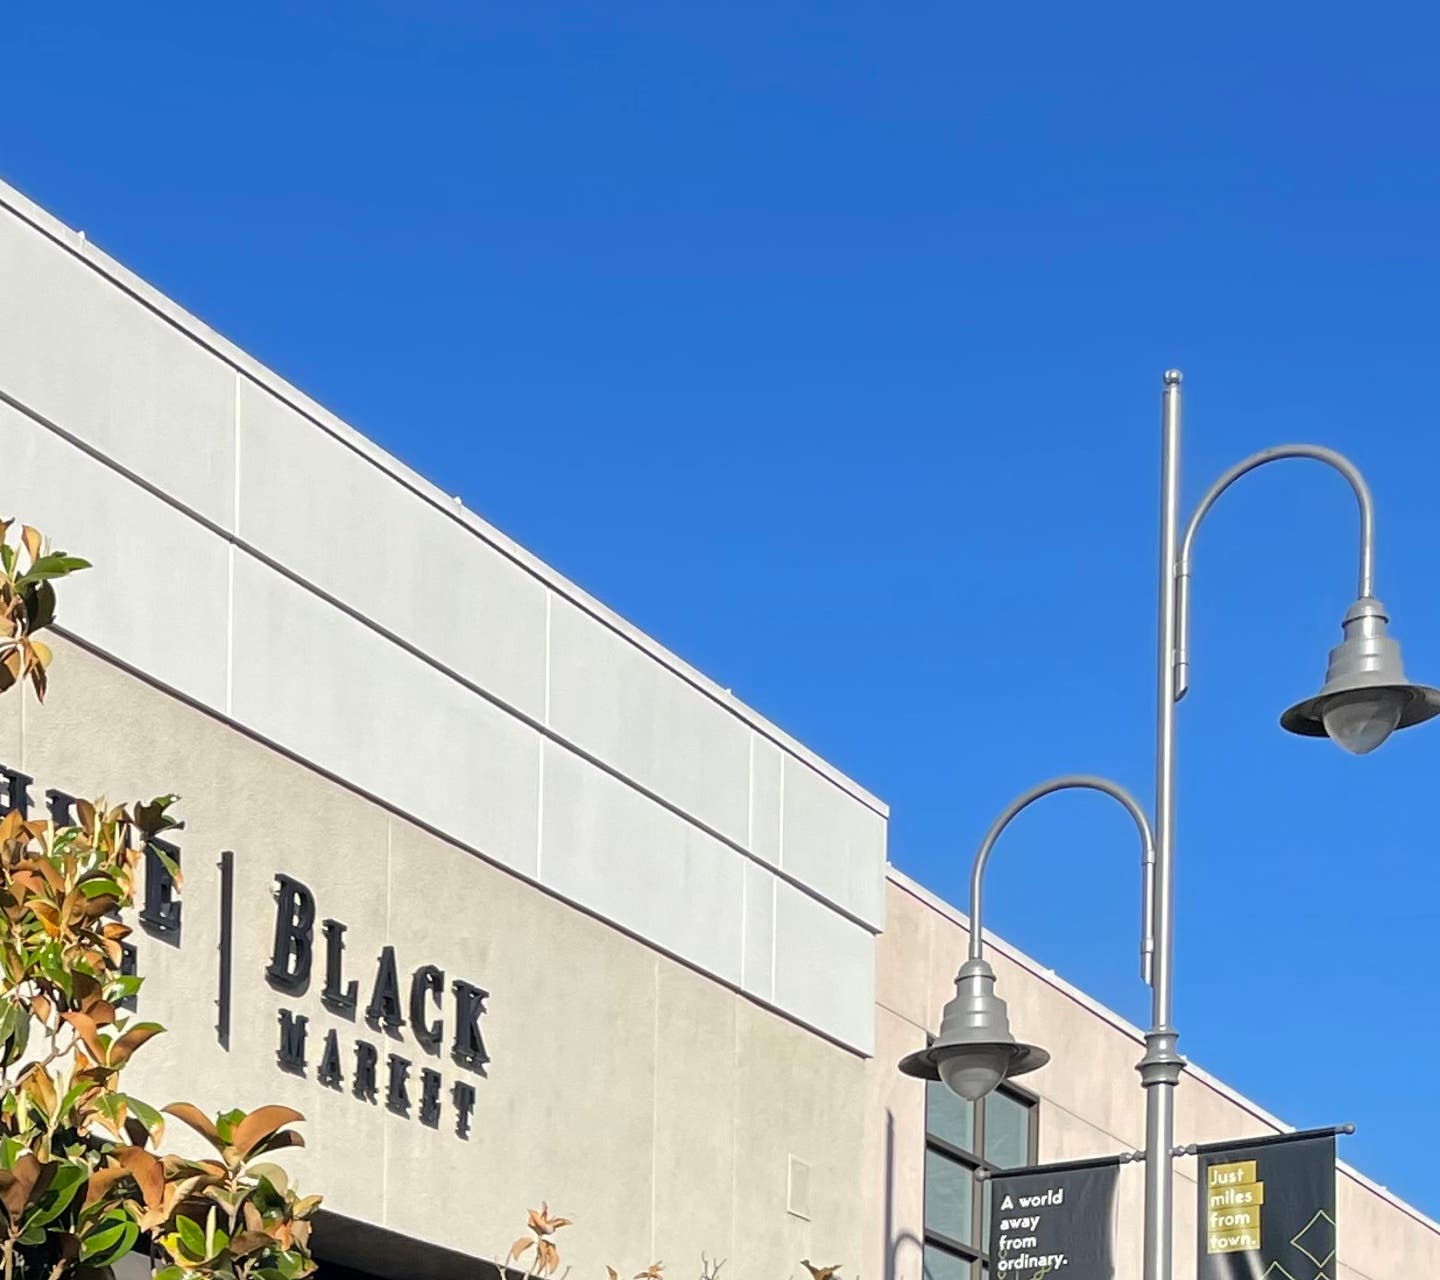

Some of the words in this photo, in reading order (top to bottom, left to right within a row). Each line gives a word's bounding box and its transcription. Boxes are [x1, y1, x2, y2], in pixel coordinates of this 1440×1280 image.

[265, 873, 490, 1078] BLACK
[277, 1008, 476, 1140] MARKET
[1211, 1168, 1244, 1185] Just
[1001, 1195, 1014, 1211] A
[1019, 1188, 1064, 1208] world
[1211, 1188, 1253, 1207] miles
[1000, 1216, 1040, 1232] away
[1210, 1212, 1251, 1228] from
[1000, 1234, 1037, 1251] from
[1211, 1234, 1257, 1249] town.
[998, 1253, 1068, 1271] ordinary.
